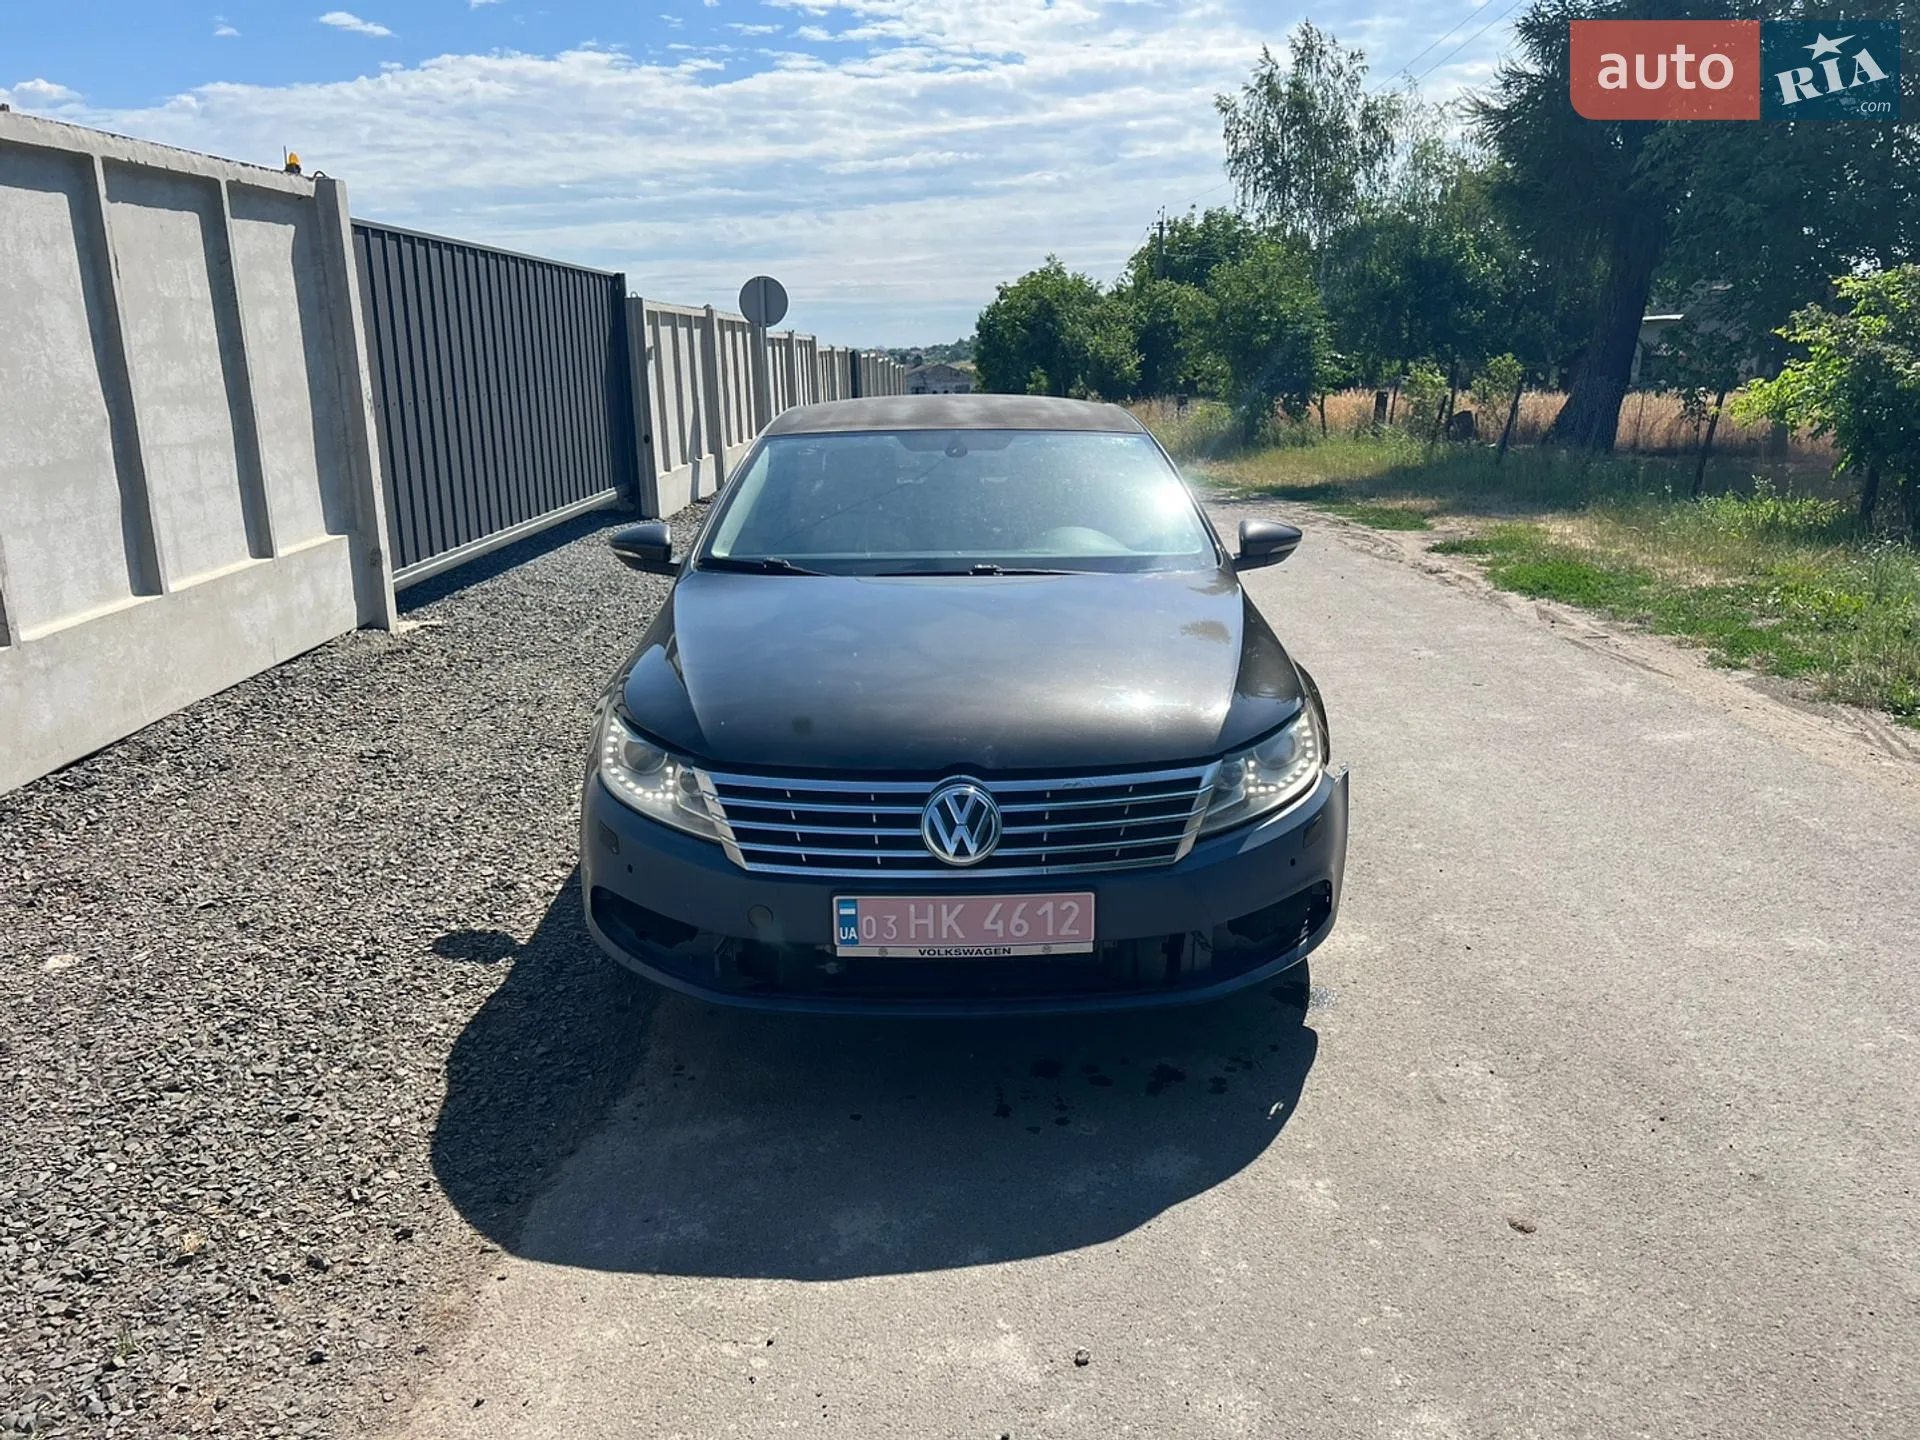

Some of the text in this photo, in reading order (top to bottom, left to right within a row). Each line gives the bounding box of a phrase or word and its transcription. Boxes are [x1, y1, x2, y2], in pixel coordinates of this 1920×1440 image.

[862, 901, 1081, 940] 03 HK 4612
[839, 927, 858, 940] UA
[918, 946, 1012, 957] VOLKSWAGEN
